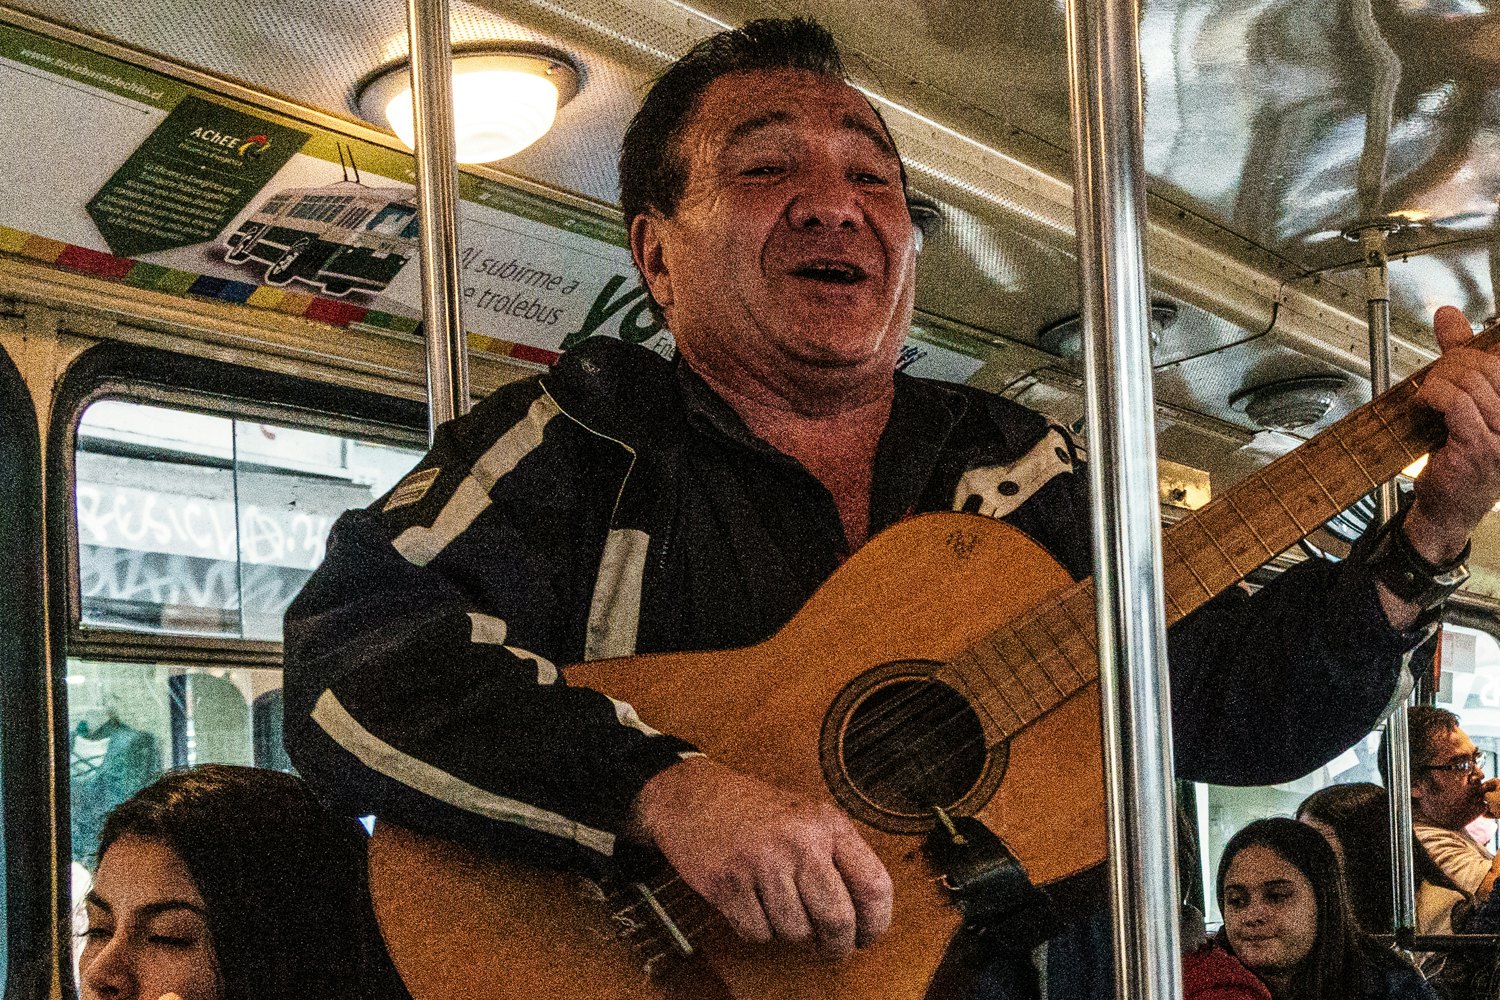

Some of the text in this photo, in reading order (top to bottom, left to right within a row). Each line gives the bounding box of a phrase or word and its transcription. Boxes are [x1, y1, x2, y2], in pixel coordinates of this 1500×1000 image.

[189, 126, 241, 149] AChEE
[474, 258, 564, 292] subirme
[561, 279, 581, 295] a
[476, 288, 564, 326] trolebus
